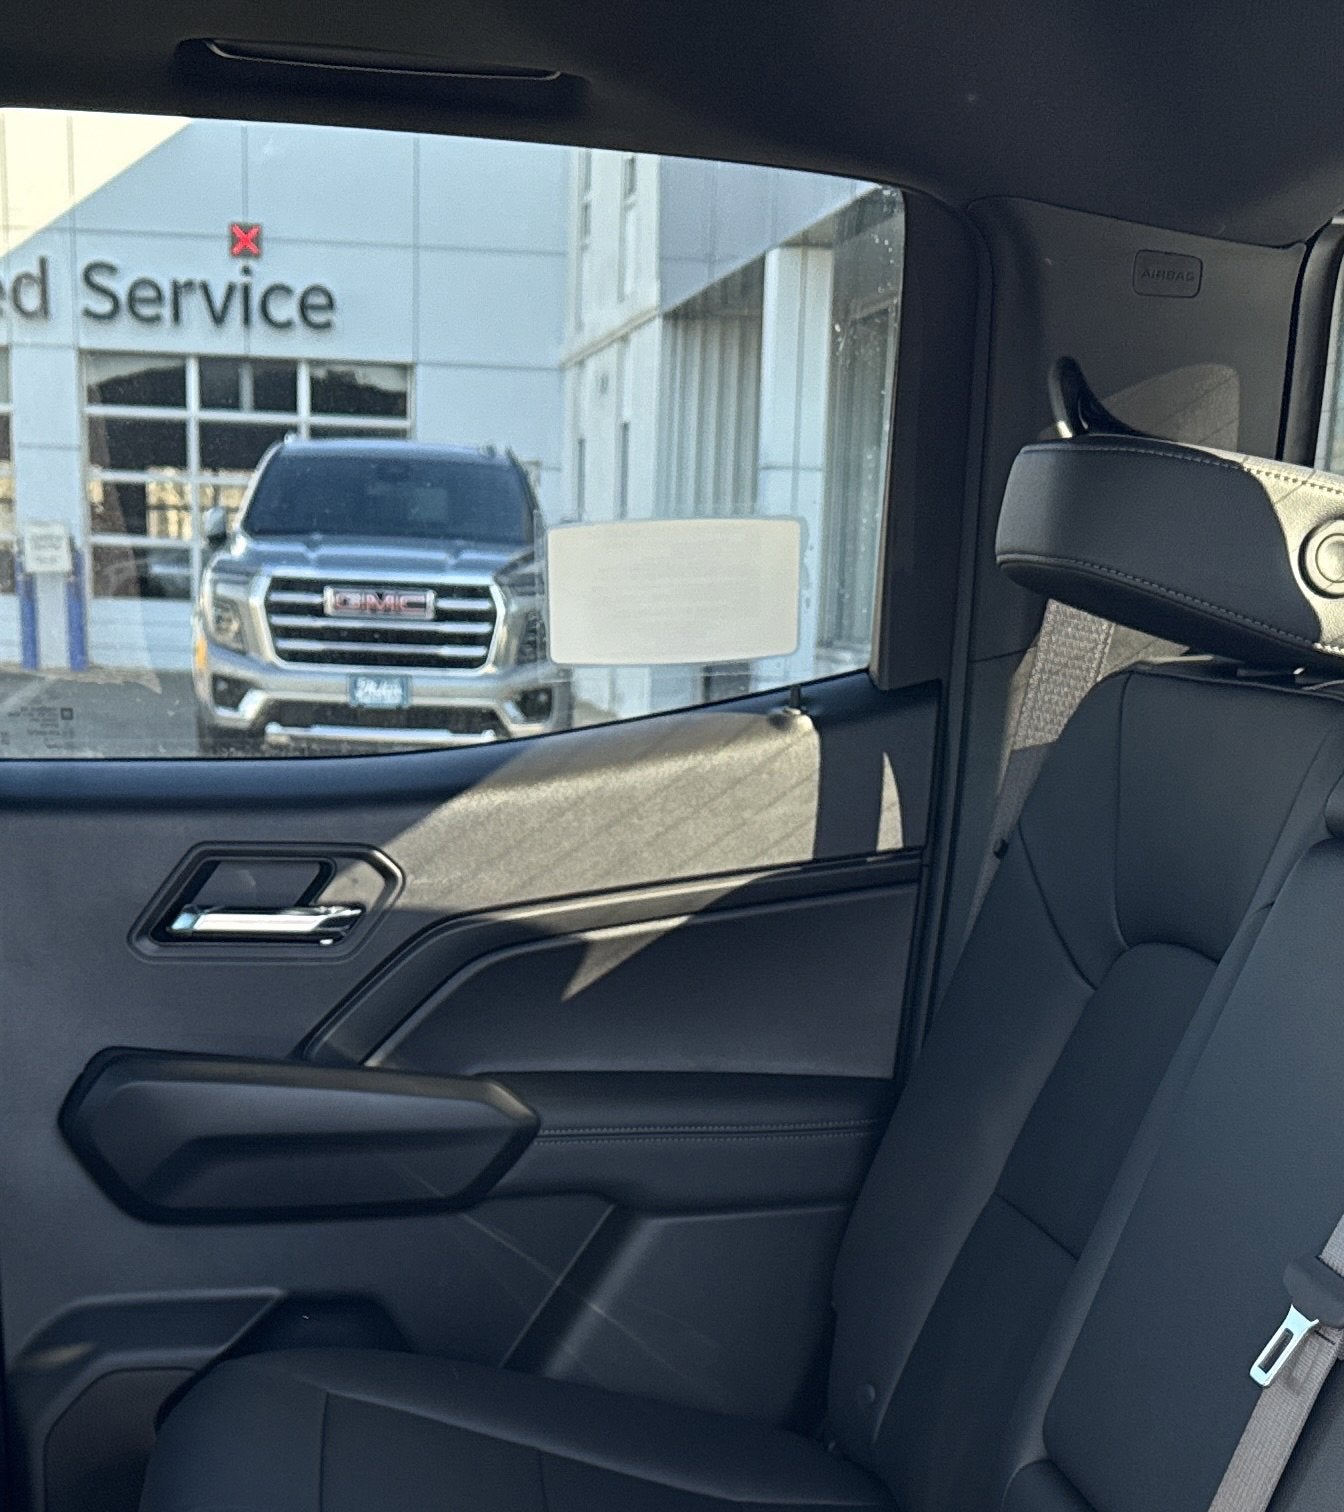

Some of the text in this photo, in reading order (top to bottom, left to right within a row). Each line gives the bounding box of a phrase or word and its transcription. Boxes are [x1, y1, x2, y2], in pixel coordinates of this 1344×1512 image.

[1140, 269, 1196, 282] AIRBAG
[81, 258, 335, 330] Service
[334, 591, 427, 614] GMC
